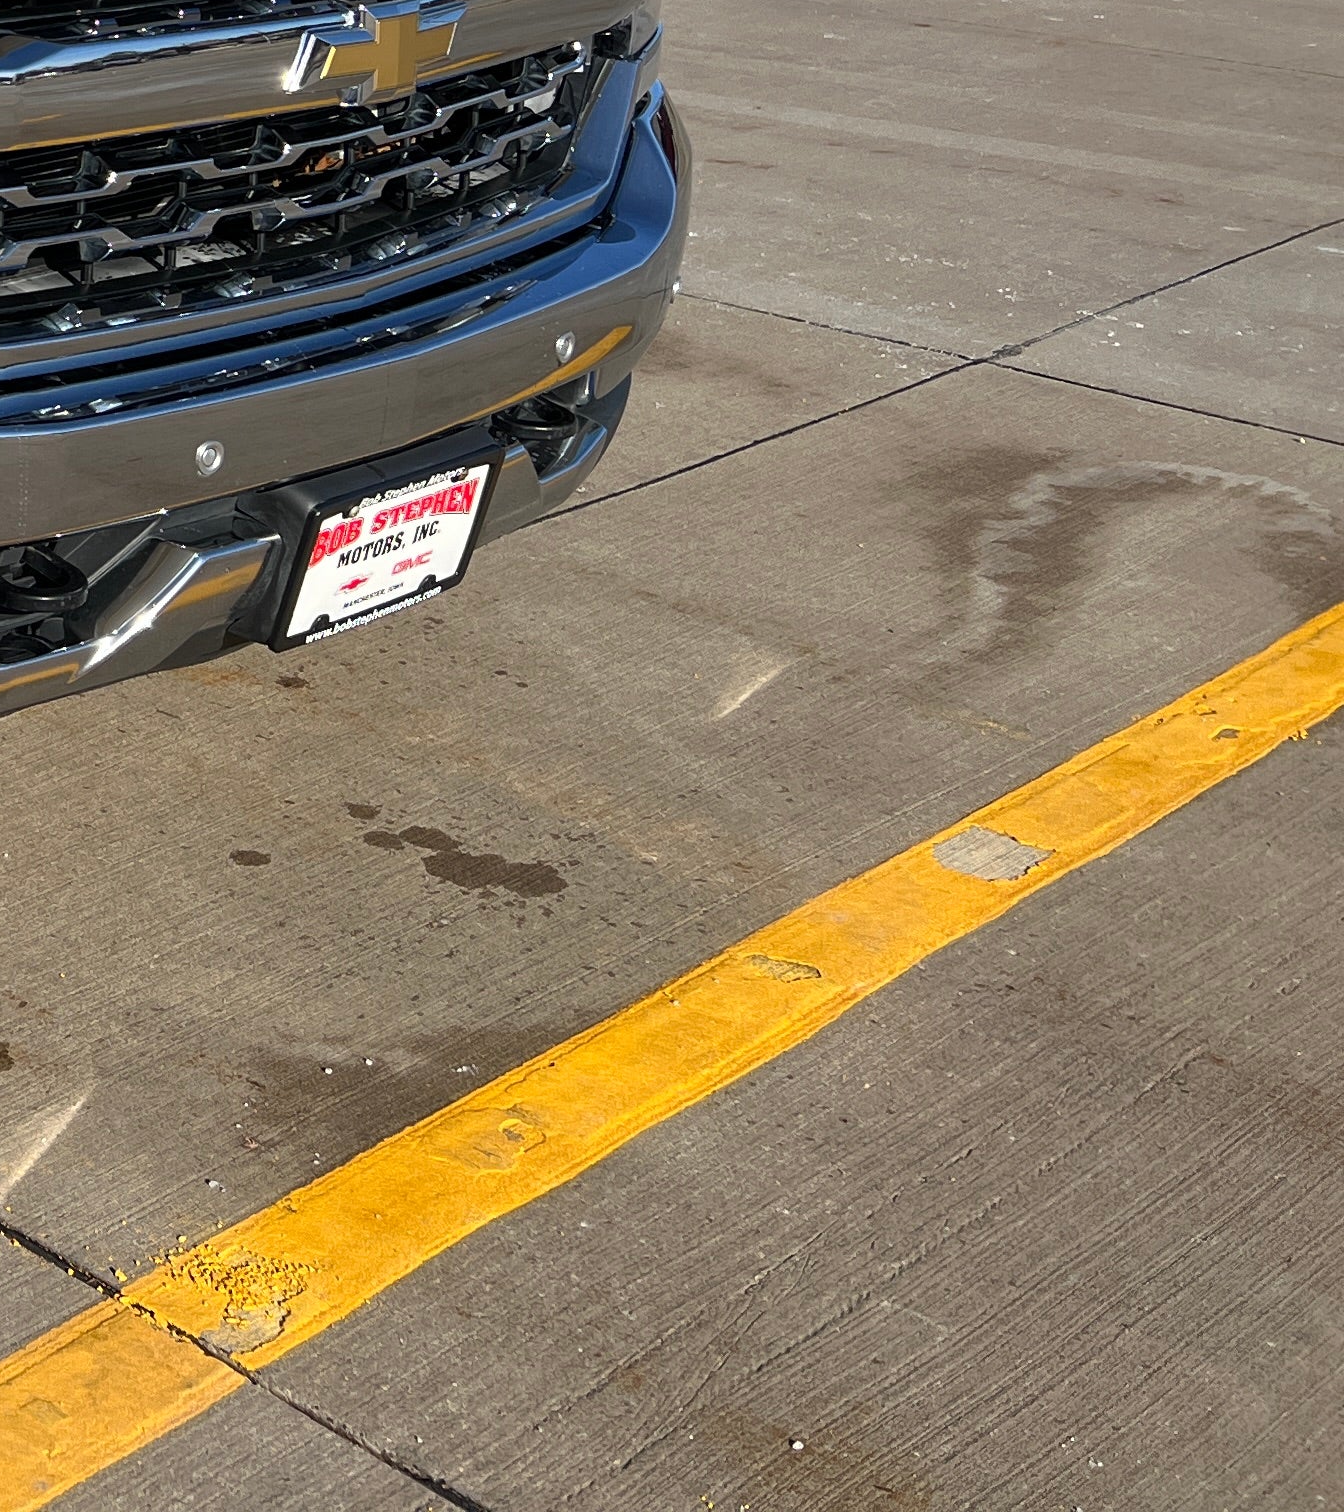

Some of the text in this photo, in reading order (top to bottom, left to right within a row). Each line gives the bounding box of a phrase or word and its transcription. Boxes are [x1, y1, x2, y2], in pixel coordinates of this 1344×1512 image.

[359, 493, 382, 508] Bob
[307, 477, 480, 569] BOB STEPHEN
[336, 520, 442, 568] MOTORS, INC.
[391, 550, 433, 575] GMC
